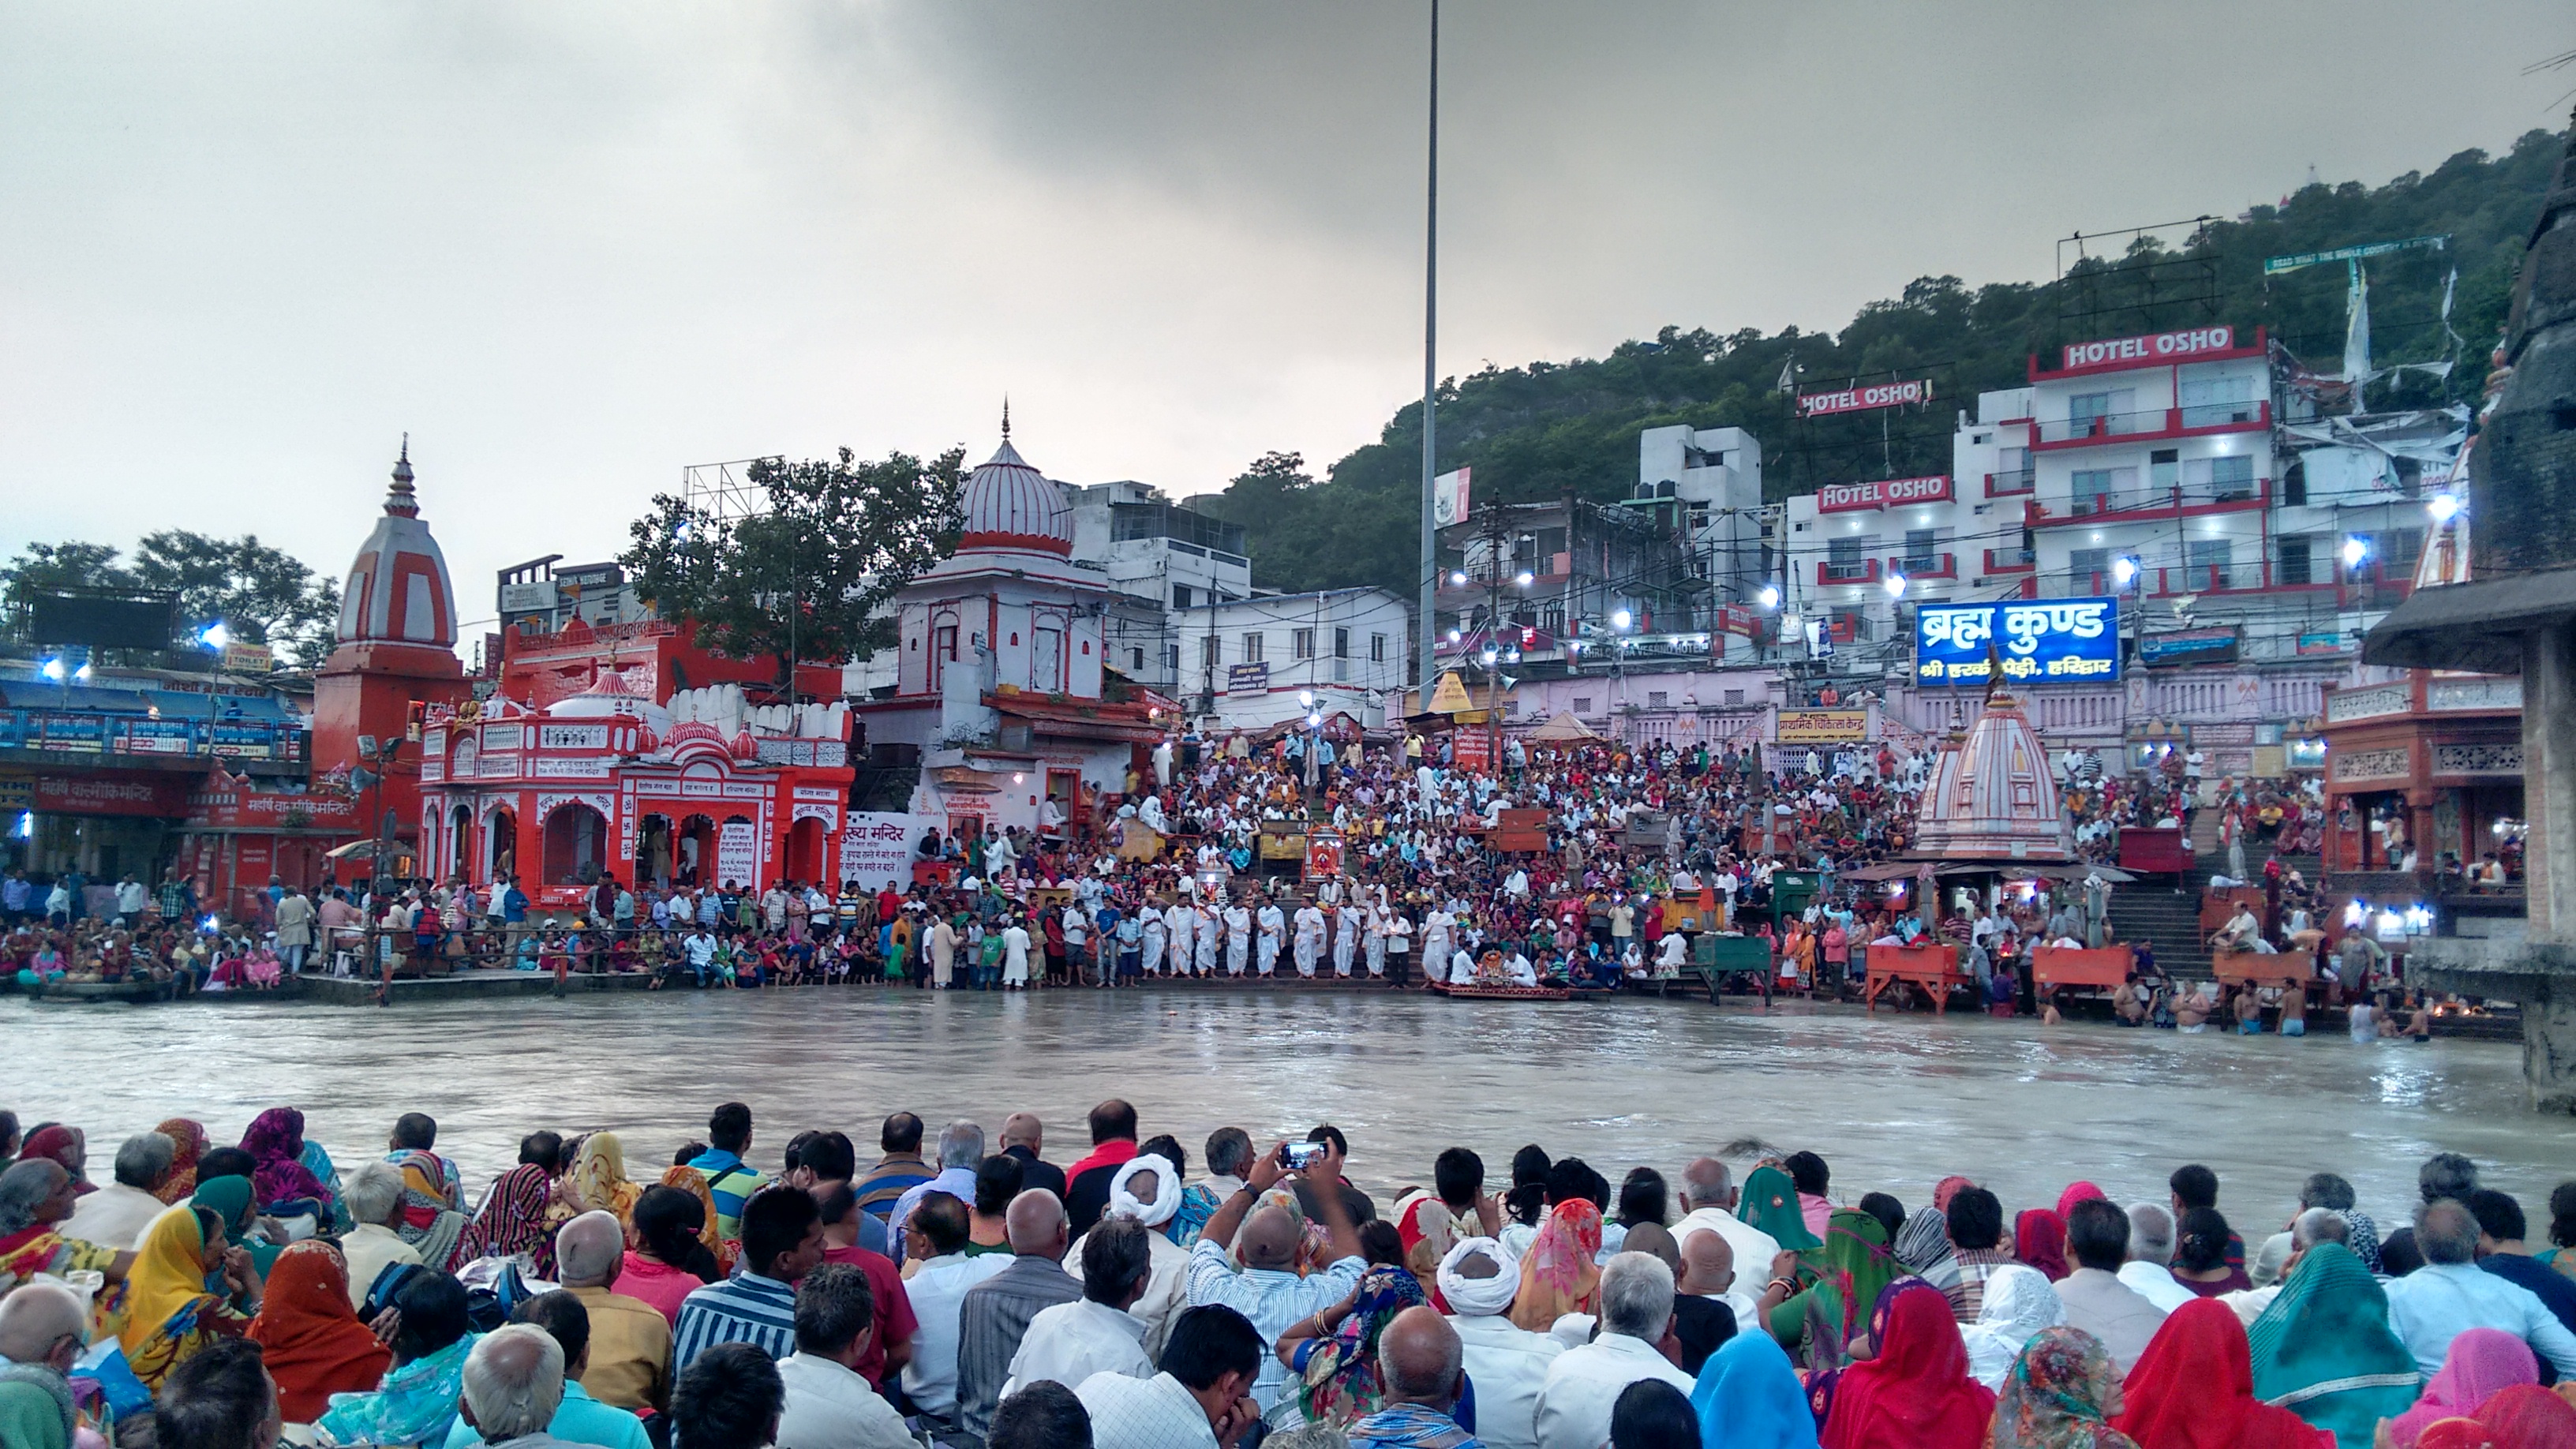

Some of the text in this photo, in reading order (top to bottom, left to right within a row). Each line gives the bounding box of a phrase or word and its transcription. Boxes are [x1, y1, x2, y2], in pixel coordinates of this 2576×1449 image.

[2272, 257, 2293, 268] READ
[2295, 253, 2316, 264] WHAT
[2318, 251, 2333, 261] THE
[2334, 246, 2362, 258] WHOLE
[2069, 326, 2230, 368] HOTEL OSHO
[1802, 382, 1918, 413] HOTEL OSHO
[1822, 477, 1944, 507] HOTEL OSHO
[2005, 603, 2108, 654] कुण्ड
[1582, 647, 1603, 659] SHRI
[1676, 642, 1705, 654] HOTEL
[1919, 660, 1944, 678] श्री
[2047, 655, 2113, 676] हरिद्वार
[1779, 717, 1864, 731] प्राथमिक चिकित्सा केन्द्र
[72, 781, 118, 800] वाल्मीकि
[596, 795, 612, 810] मन्दिर
[815, 805, 834, 820] मन्दिर
[871, 822, 905, 842] मन्दिर
[856, 863, 863, 871] पर
